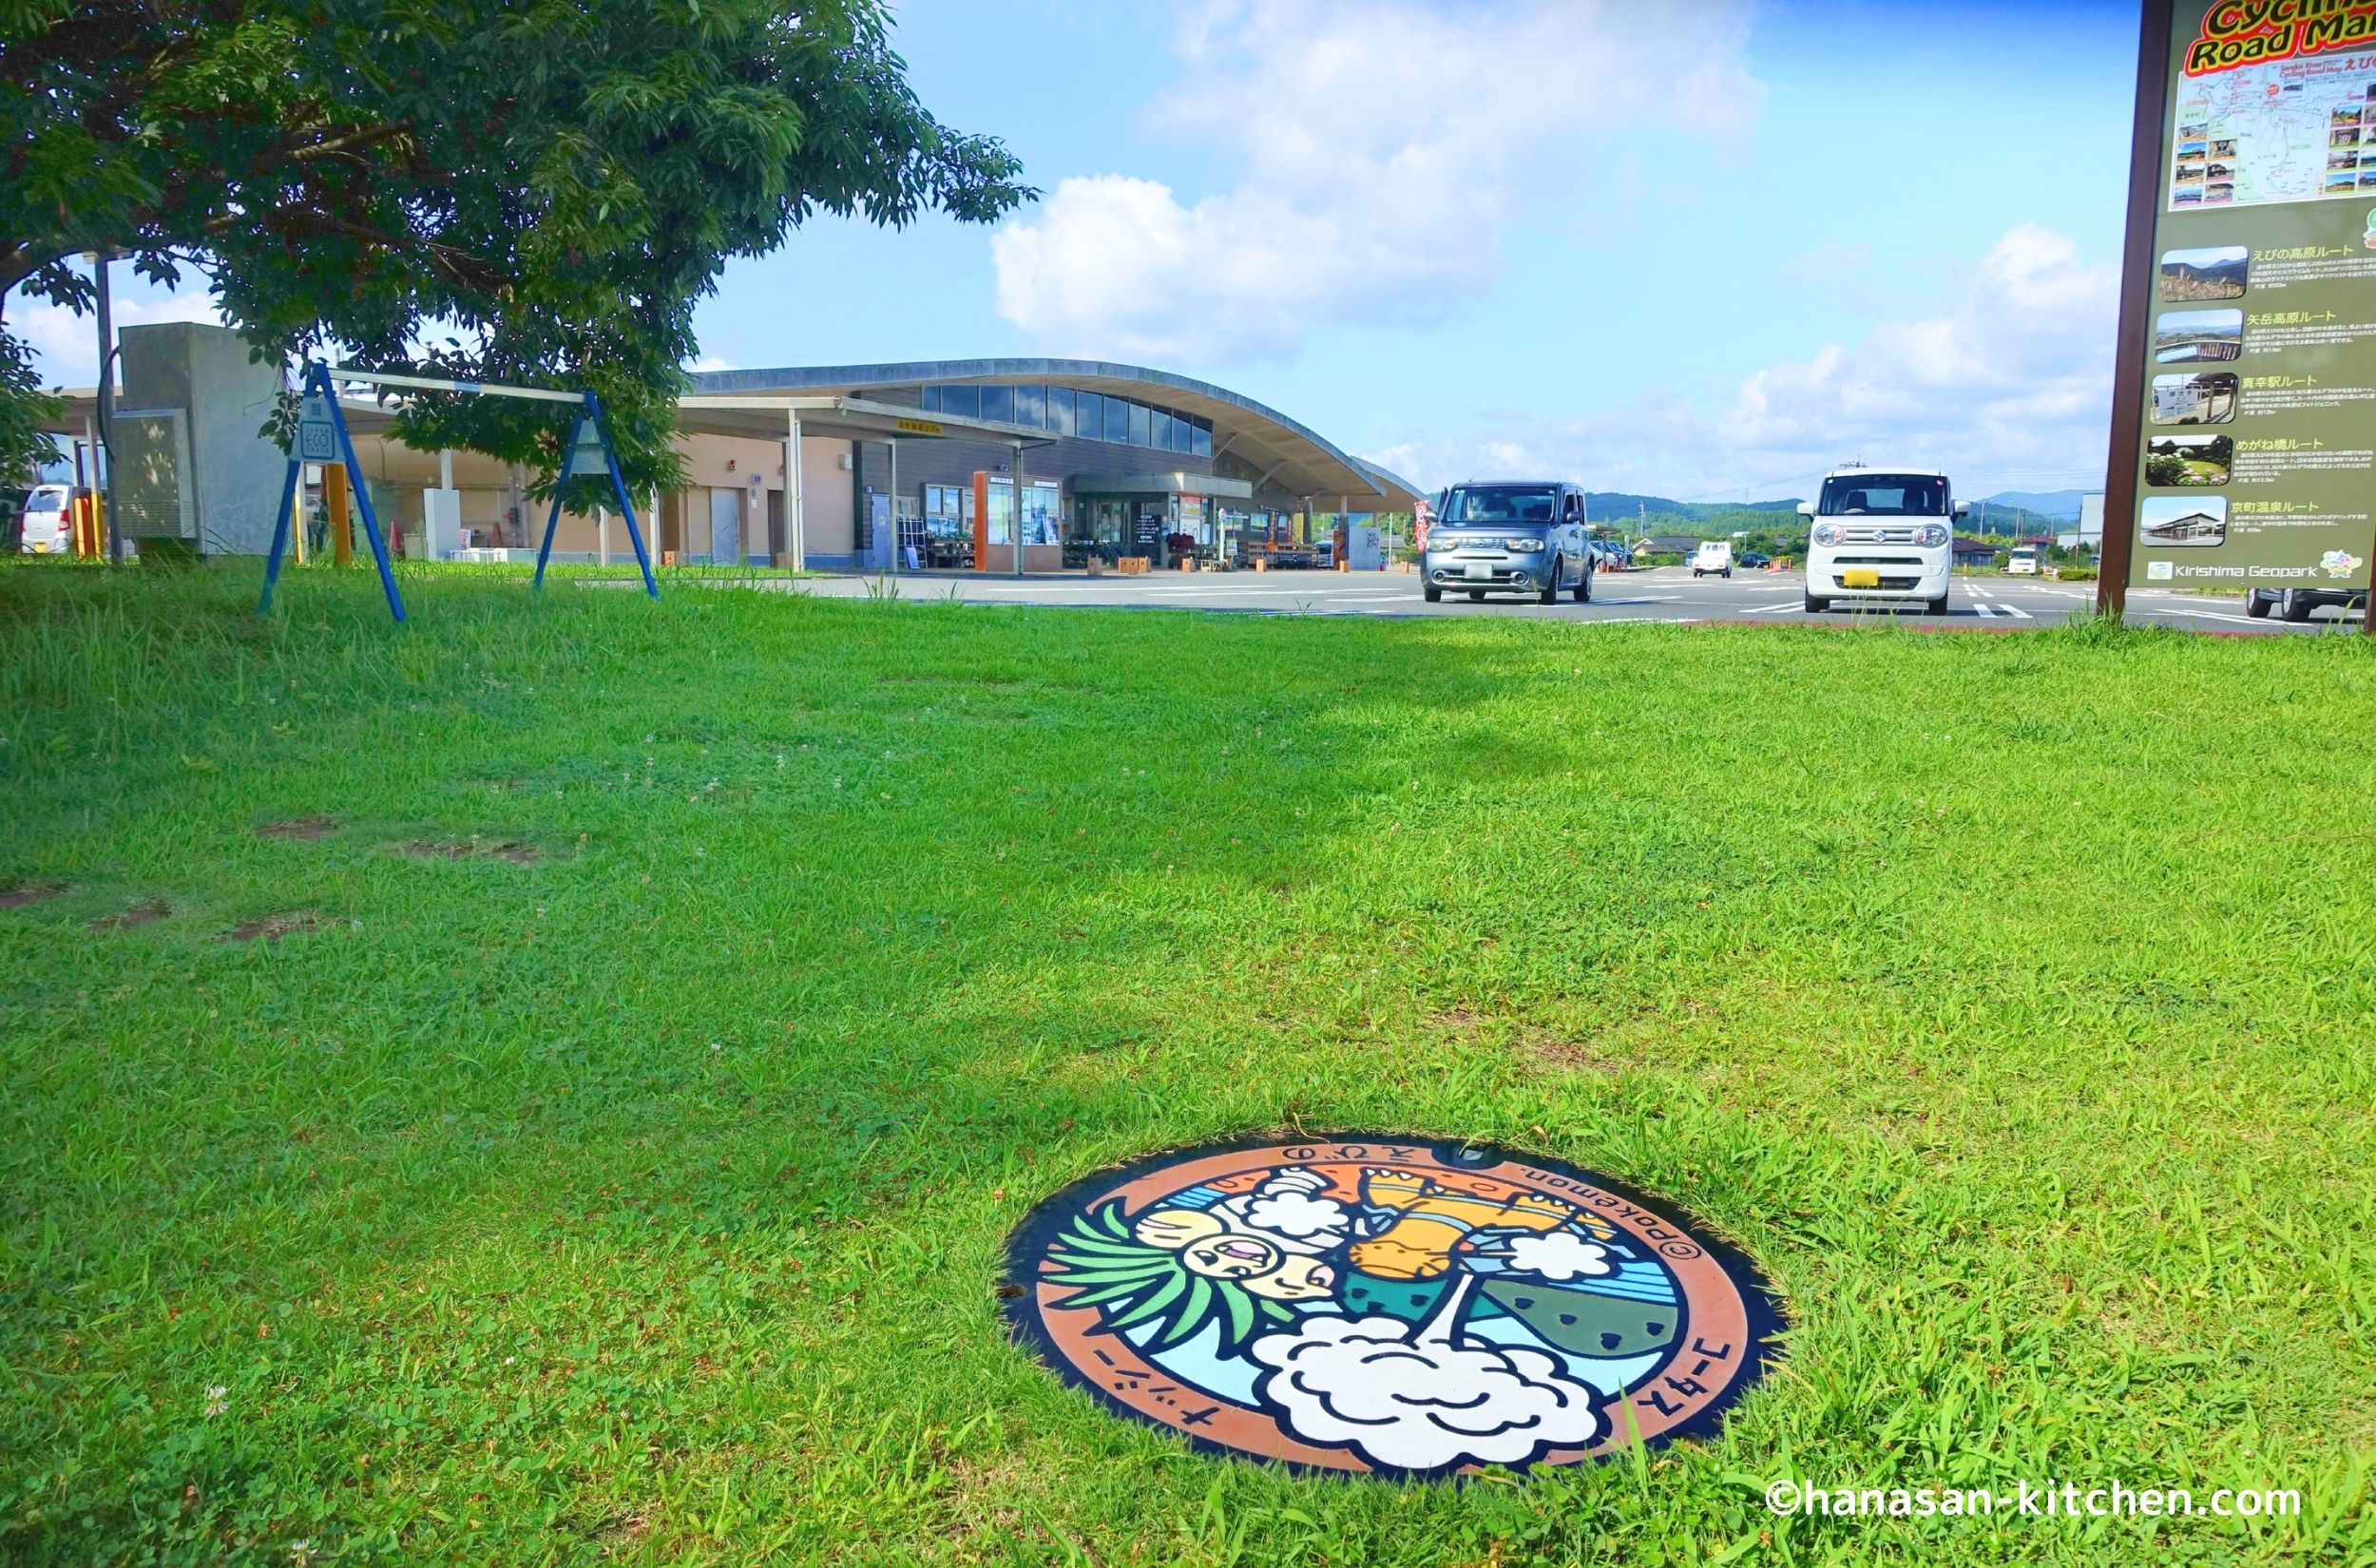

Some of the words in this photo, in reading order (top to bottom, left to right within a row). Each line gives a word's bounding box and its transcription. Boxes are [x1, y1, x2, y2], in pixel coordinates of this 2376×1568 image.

[2190, 24, 2292, 70] Road
[2279, 69, 2305, 79] Cycling
[2326, 66, 2343, 74] Map
[2251, 244, 2353, 261] えびの高原ルート
[2246, 310, 2337, 326] 矢岳高原ルート
[2241, 374, 2318, 390] 真幸駅ルート
[306, 432, 329, 447] ECO
[2236, 438, 2324, 451] めがね橋ルート
[2230, 501, 2319, 513] 京町温泉ルート
[2175, 565, 2244, 577] Kirishima
[2249, 565, 2318, 579] Geopark
[1283, 1145, 1415, 1162] えびの
[1636, 1337, 1731, 1417] コータス
[1093, 1348, 1220, 1425] ナッシー
